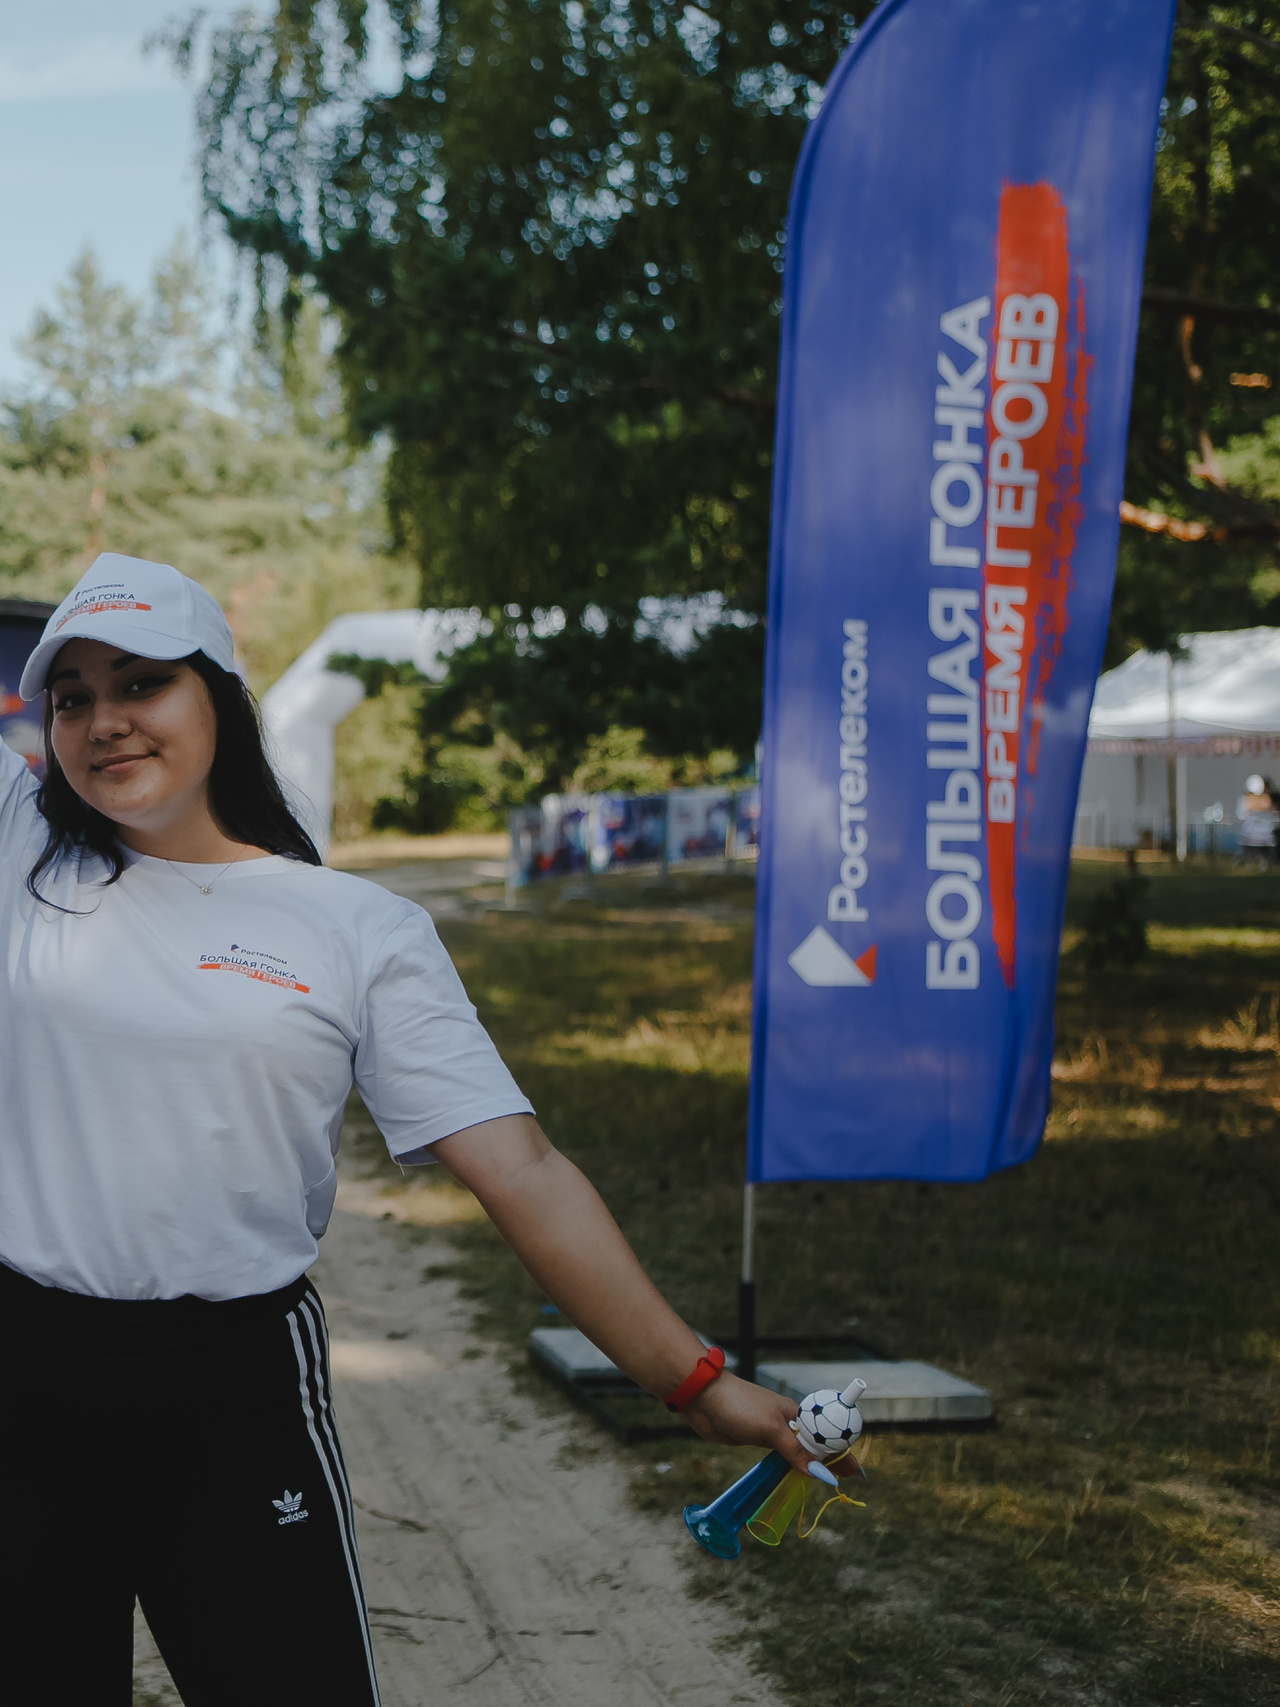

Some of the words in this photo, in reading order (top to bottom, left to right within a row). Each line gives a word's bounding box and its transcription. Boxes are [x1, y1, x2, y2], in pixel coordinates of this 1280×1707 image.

[928, 294, 992, 569] ГОНКА
[986, 292, 1059, 568] ГЕРОЕВ
[97, 600, 137, 609] ГЕРОЕВ
[98, 593, 136, 601] ГОНКА
[985, 584, 1028, 824] ВРЕМЯ
[827, 618, 869, 922] Ростелеком
[925, 587, 982, 990] БОЛЬШАЯ
[199, 954, 258, 969] БОЛЬШАЯ
[260, 963, 298, 980] ГОНКА
[240, 948, 288, 965] Ростелеком
[219, 963, 256, 977] ВРЕМЯ
[257, 970, 297, 989] ГЕРОЕВ
[278, 1509, 309, 1525] adidas
